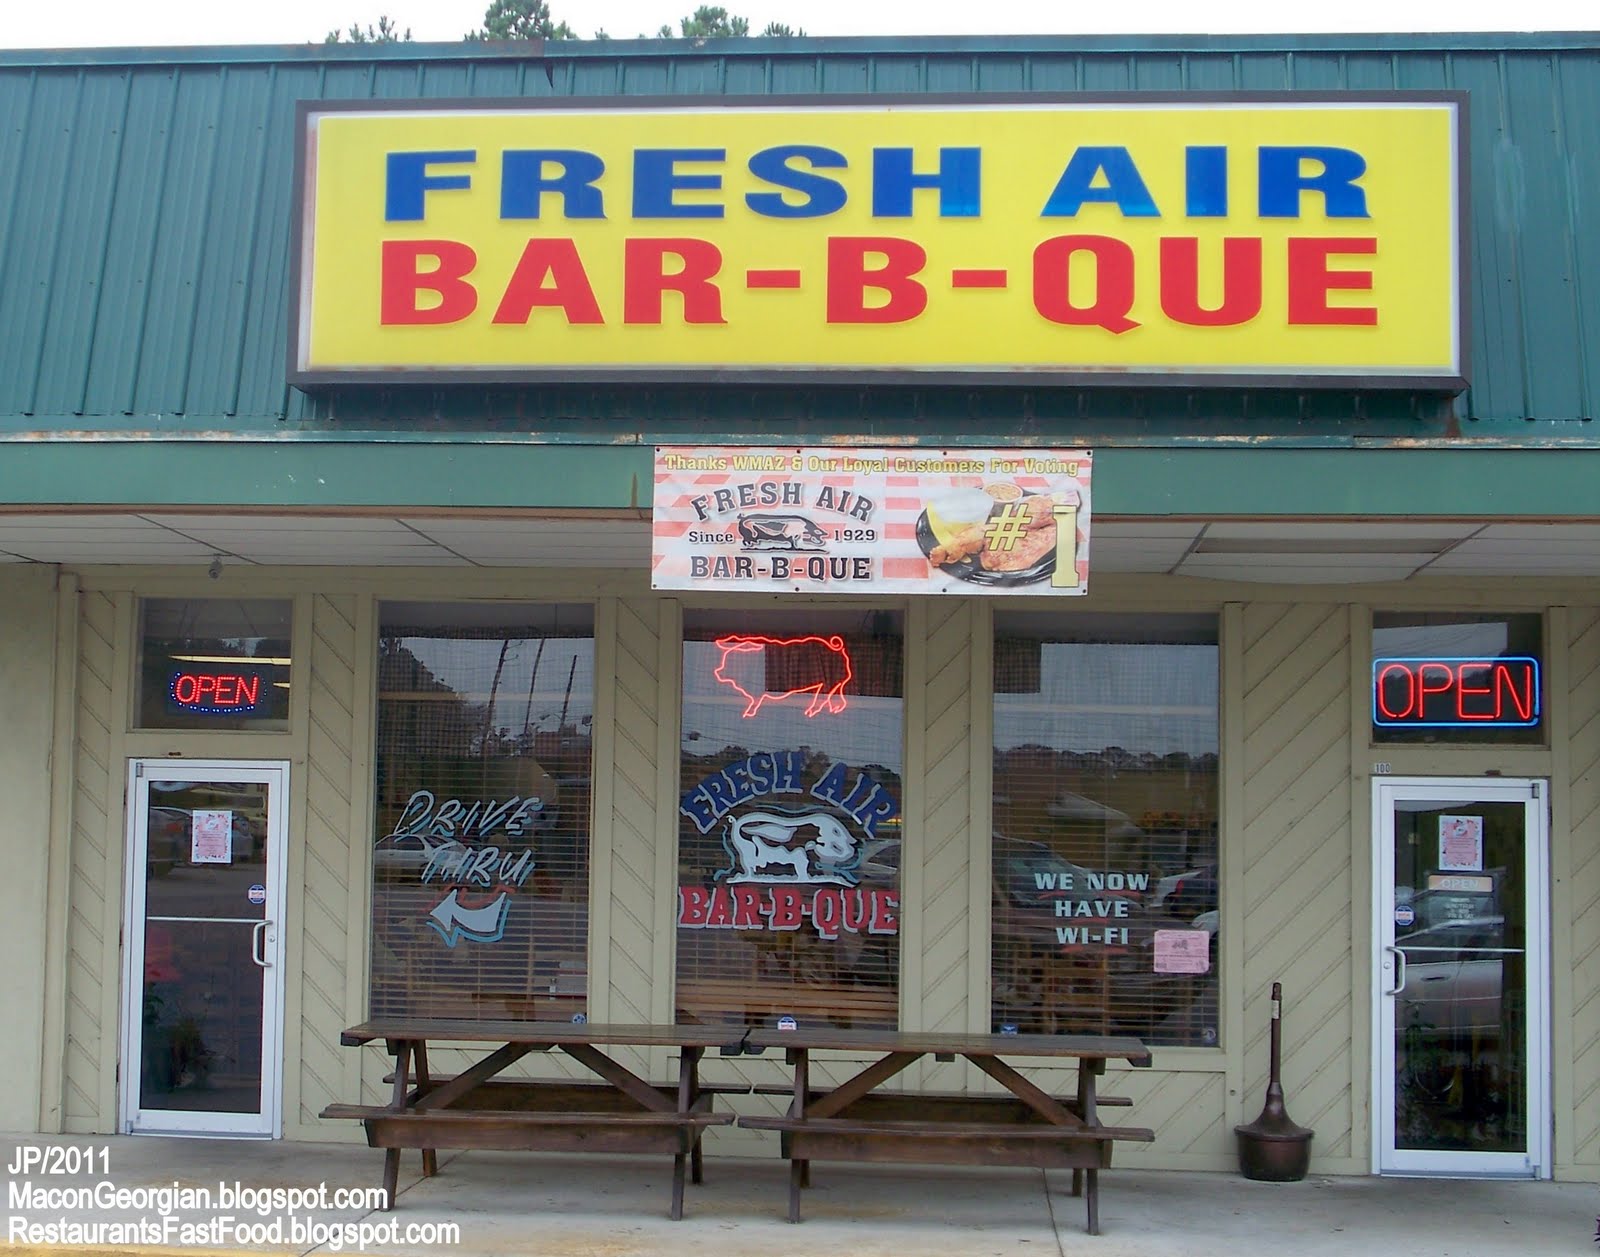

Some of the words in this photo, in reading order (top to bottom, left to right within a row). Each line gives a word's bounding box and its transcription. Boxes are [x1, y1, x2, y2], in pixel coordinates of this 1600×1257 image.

[385, 145, 981, 222] FRESH
[1040, 145, 1371, 218] AIR
[380, 234, 1378, 334] BAR-B-QUE
[664, 454, 727, 471] Thanks
[733, 455, 786, 471] WMAZ
[791, 457, 803, 471] &
[808, 457, 837, 472] Our
[842, 456, 889, 476] Loyal
[894, 458, 985, 474] Customers
[990, 459, 1019, 474] For
[1023, 459, 1079, 477] Voting
[691, 482, 802, 522] FRESH
[815, 485, 873, 523] AIR
[688, 530, 734, 544] Since
[834, 529, 876, 542] 1929
[690, 555, 871, 582] BAR-B-QUE
[175, 674, 260, 705] OPEN
[1379, 664, 1532, 720] OPEN
[1375, 763, 1391, 773] 100
[680, 752, 805, 835] FRESH
[810, 762, 897, 839] AIR
[393, 789, 545, 843] DRIVE
[420, 840, 537, 889] THRU
[1035, 873, 1073, 890] WE
[1087, 873, 1149, 891] NOW
[1440, 878, 1478, 889] OPEN
[678, 886, 899, 940] BAR-B-QUE
[1055, 900, 1129, 918] HAVE
[1056, 927, 1129, 945] WI-FI
